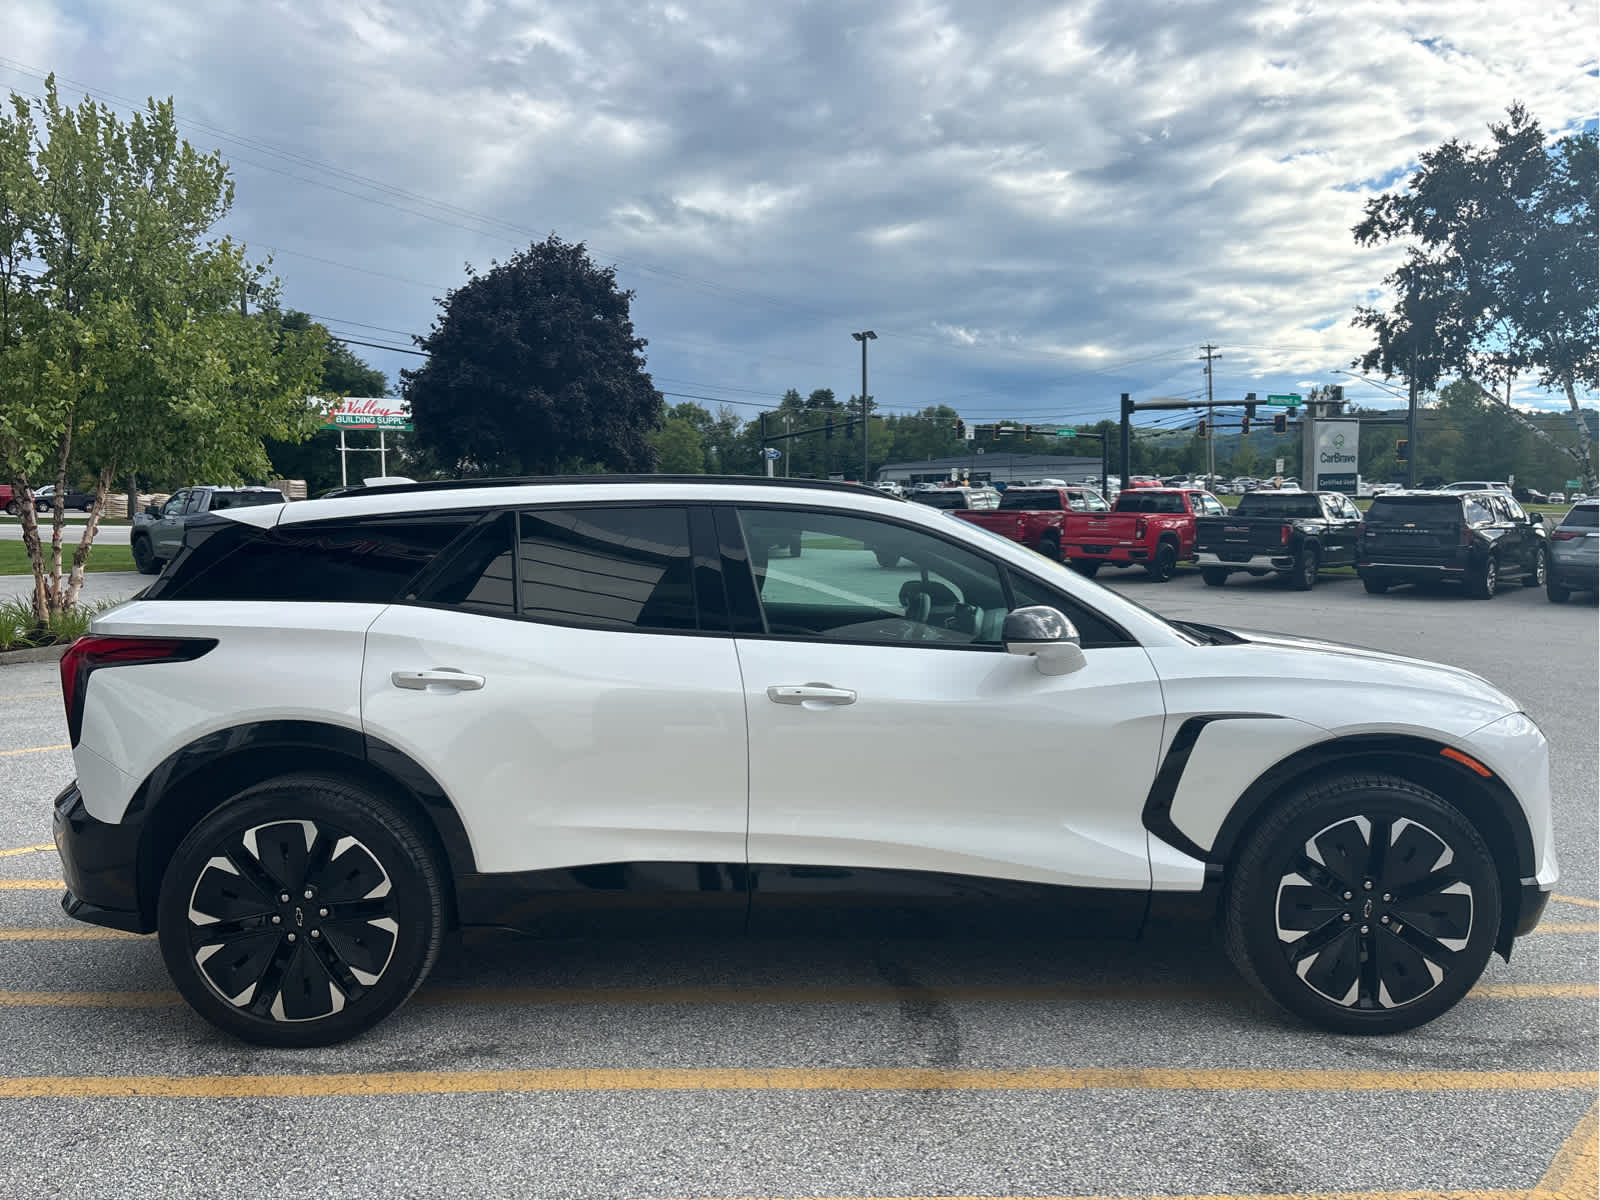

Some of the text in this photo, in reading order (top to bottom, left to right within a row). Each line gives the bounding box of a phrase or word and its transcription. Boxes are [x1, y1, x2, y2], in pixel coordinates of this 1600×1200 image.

[336, 415, 406, 424] BUILDING SUPPL
[1320, 452, 1356, 463] CarBravo
